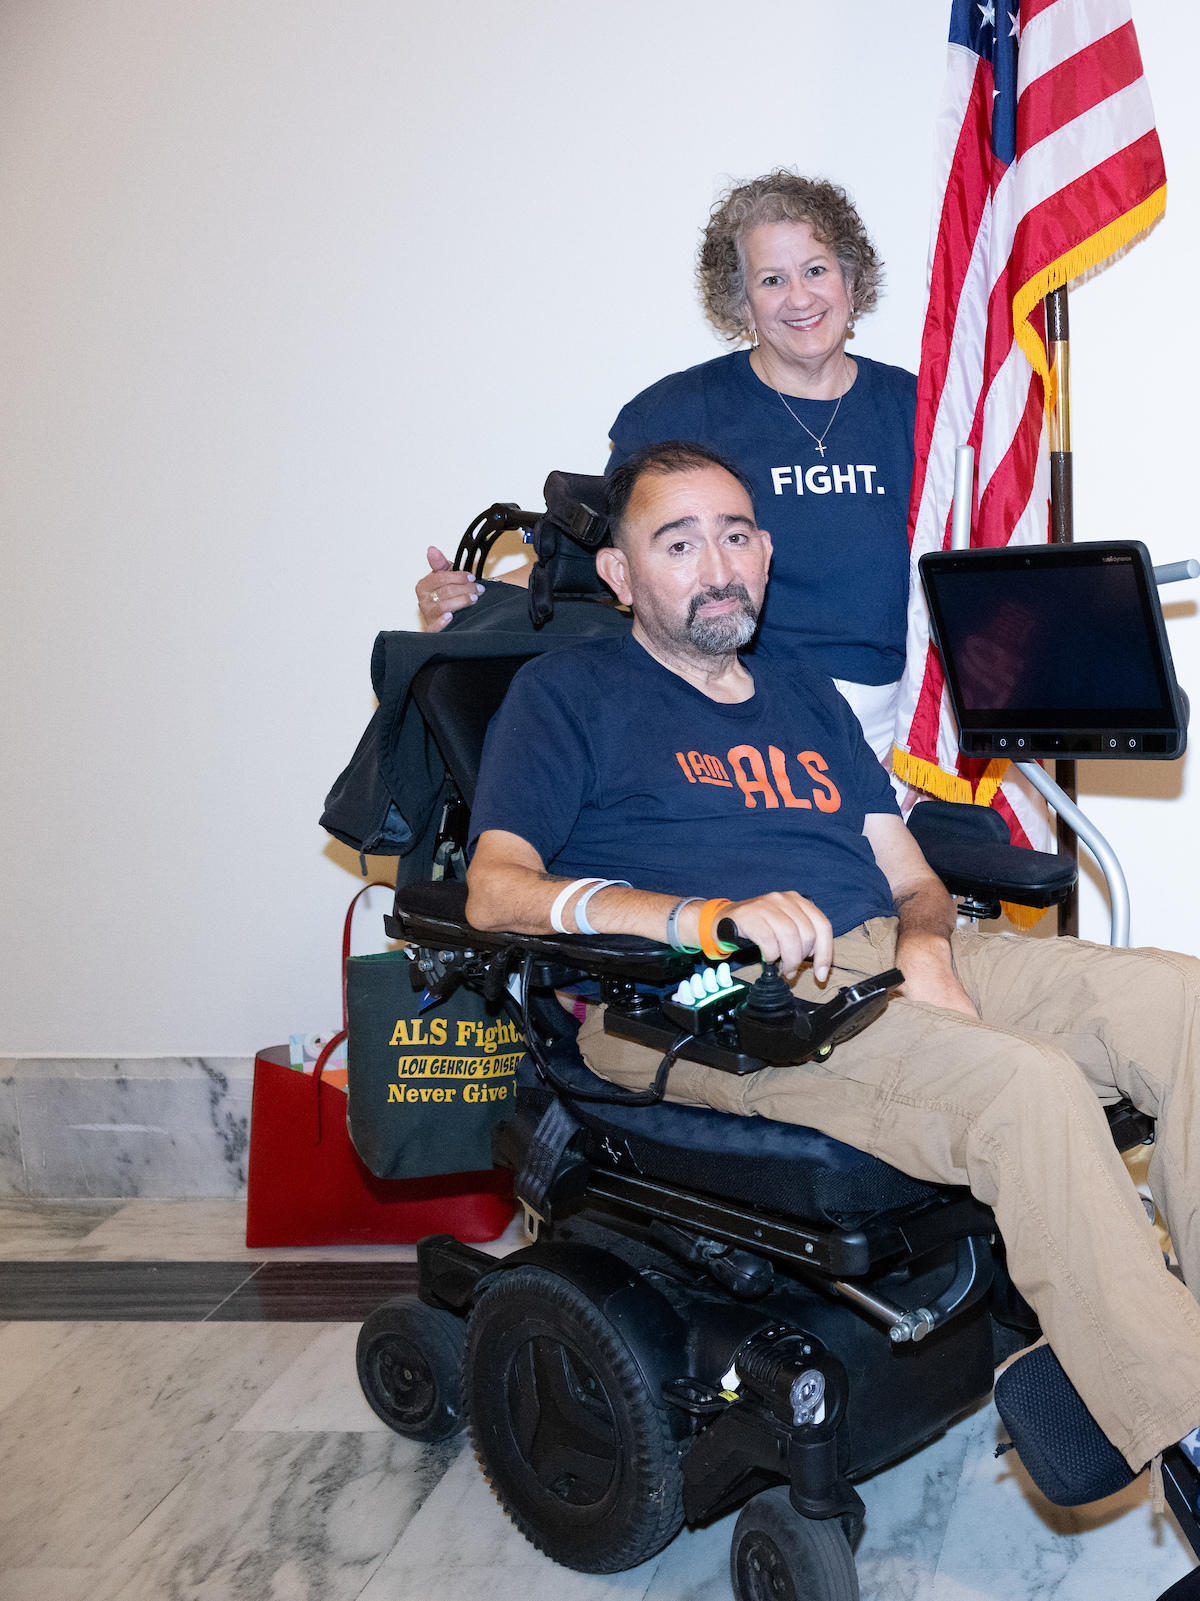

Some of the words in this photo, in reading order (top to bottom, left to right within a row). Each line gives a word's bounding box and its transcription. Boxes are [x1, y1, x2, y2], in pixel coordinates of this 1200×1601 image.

[770, 464, 886, 496] FIGHT.
[727, 744, 842, 814] ALS
[388, 1018, 449, 1046] ALS
[455, 1019, 524, 1054] Fight
[401, 1058, 426, 1076] LOU
[430, 1057, 491, 1076] GEHRIG'S
[387, 1083, 457, 1103] Never
[462, 1082, 508, 1103] Give
